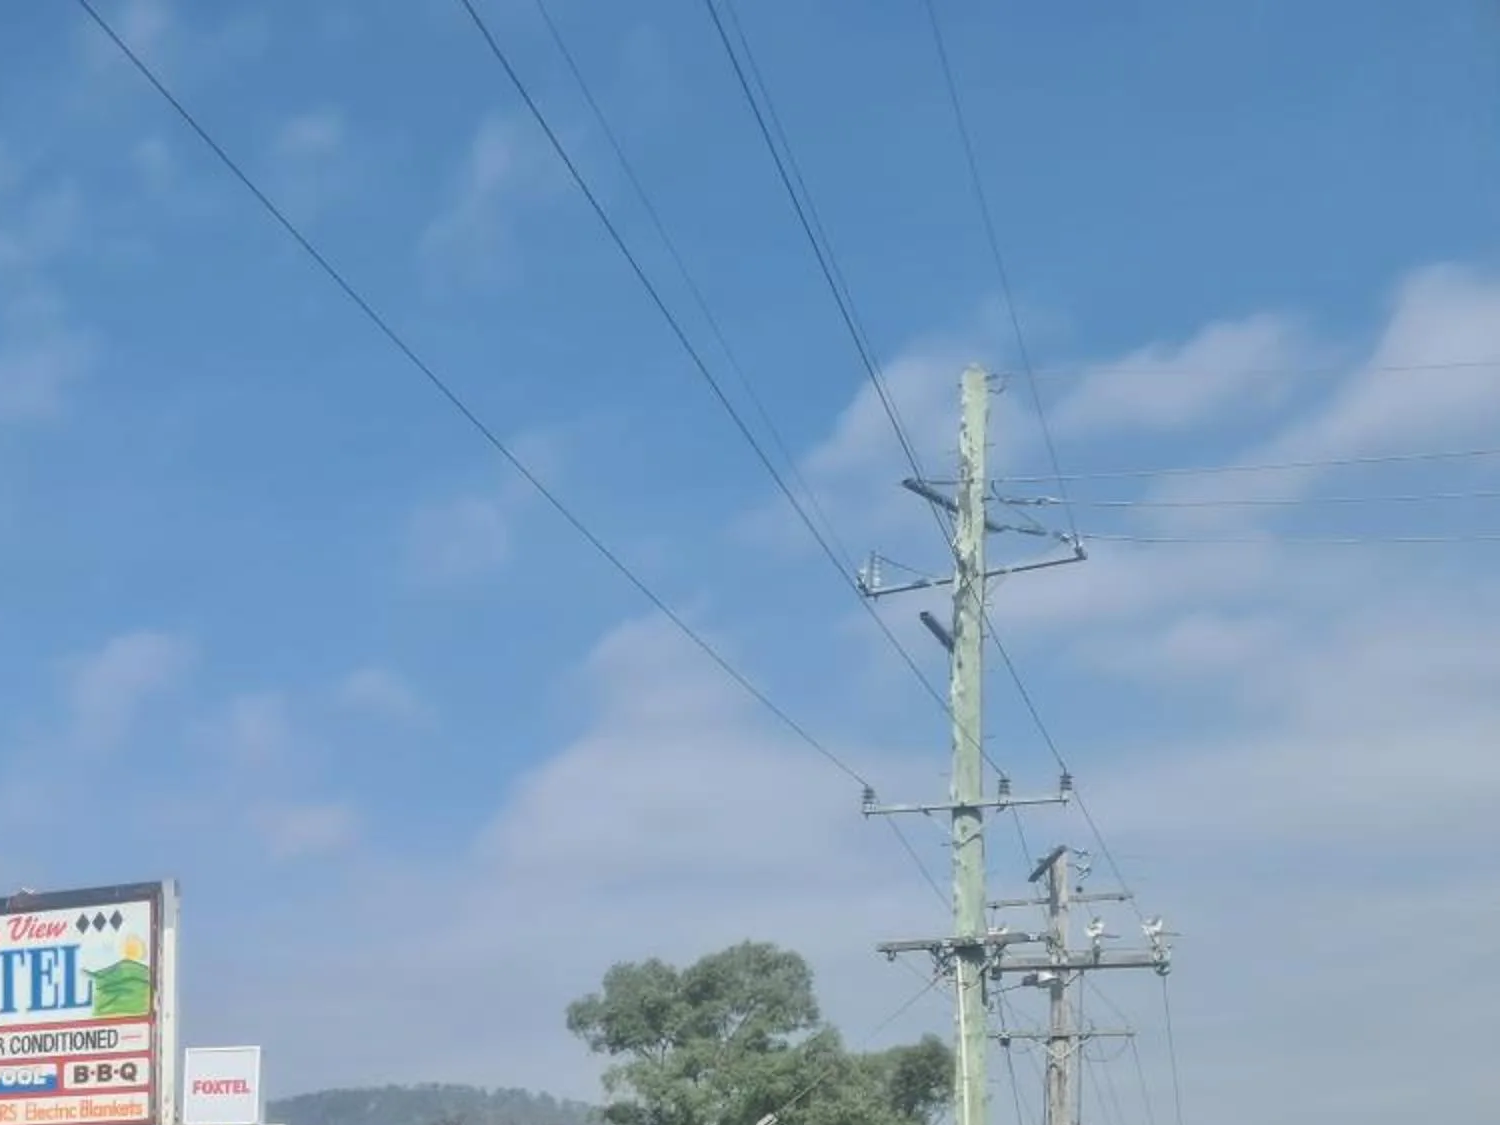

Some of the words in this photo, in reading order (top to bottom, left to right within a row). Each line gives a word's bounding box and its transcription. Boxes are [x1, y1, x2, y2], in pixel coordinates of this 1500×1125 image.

[7, 914, 68, 941] View
[10, 1029, 119, 1054] CONDITIONED
[192, 1079, 250, 1095] FOXTEL
[25, 1101, 77, 1120] Electric
